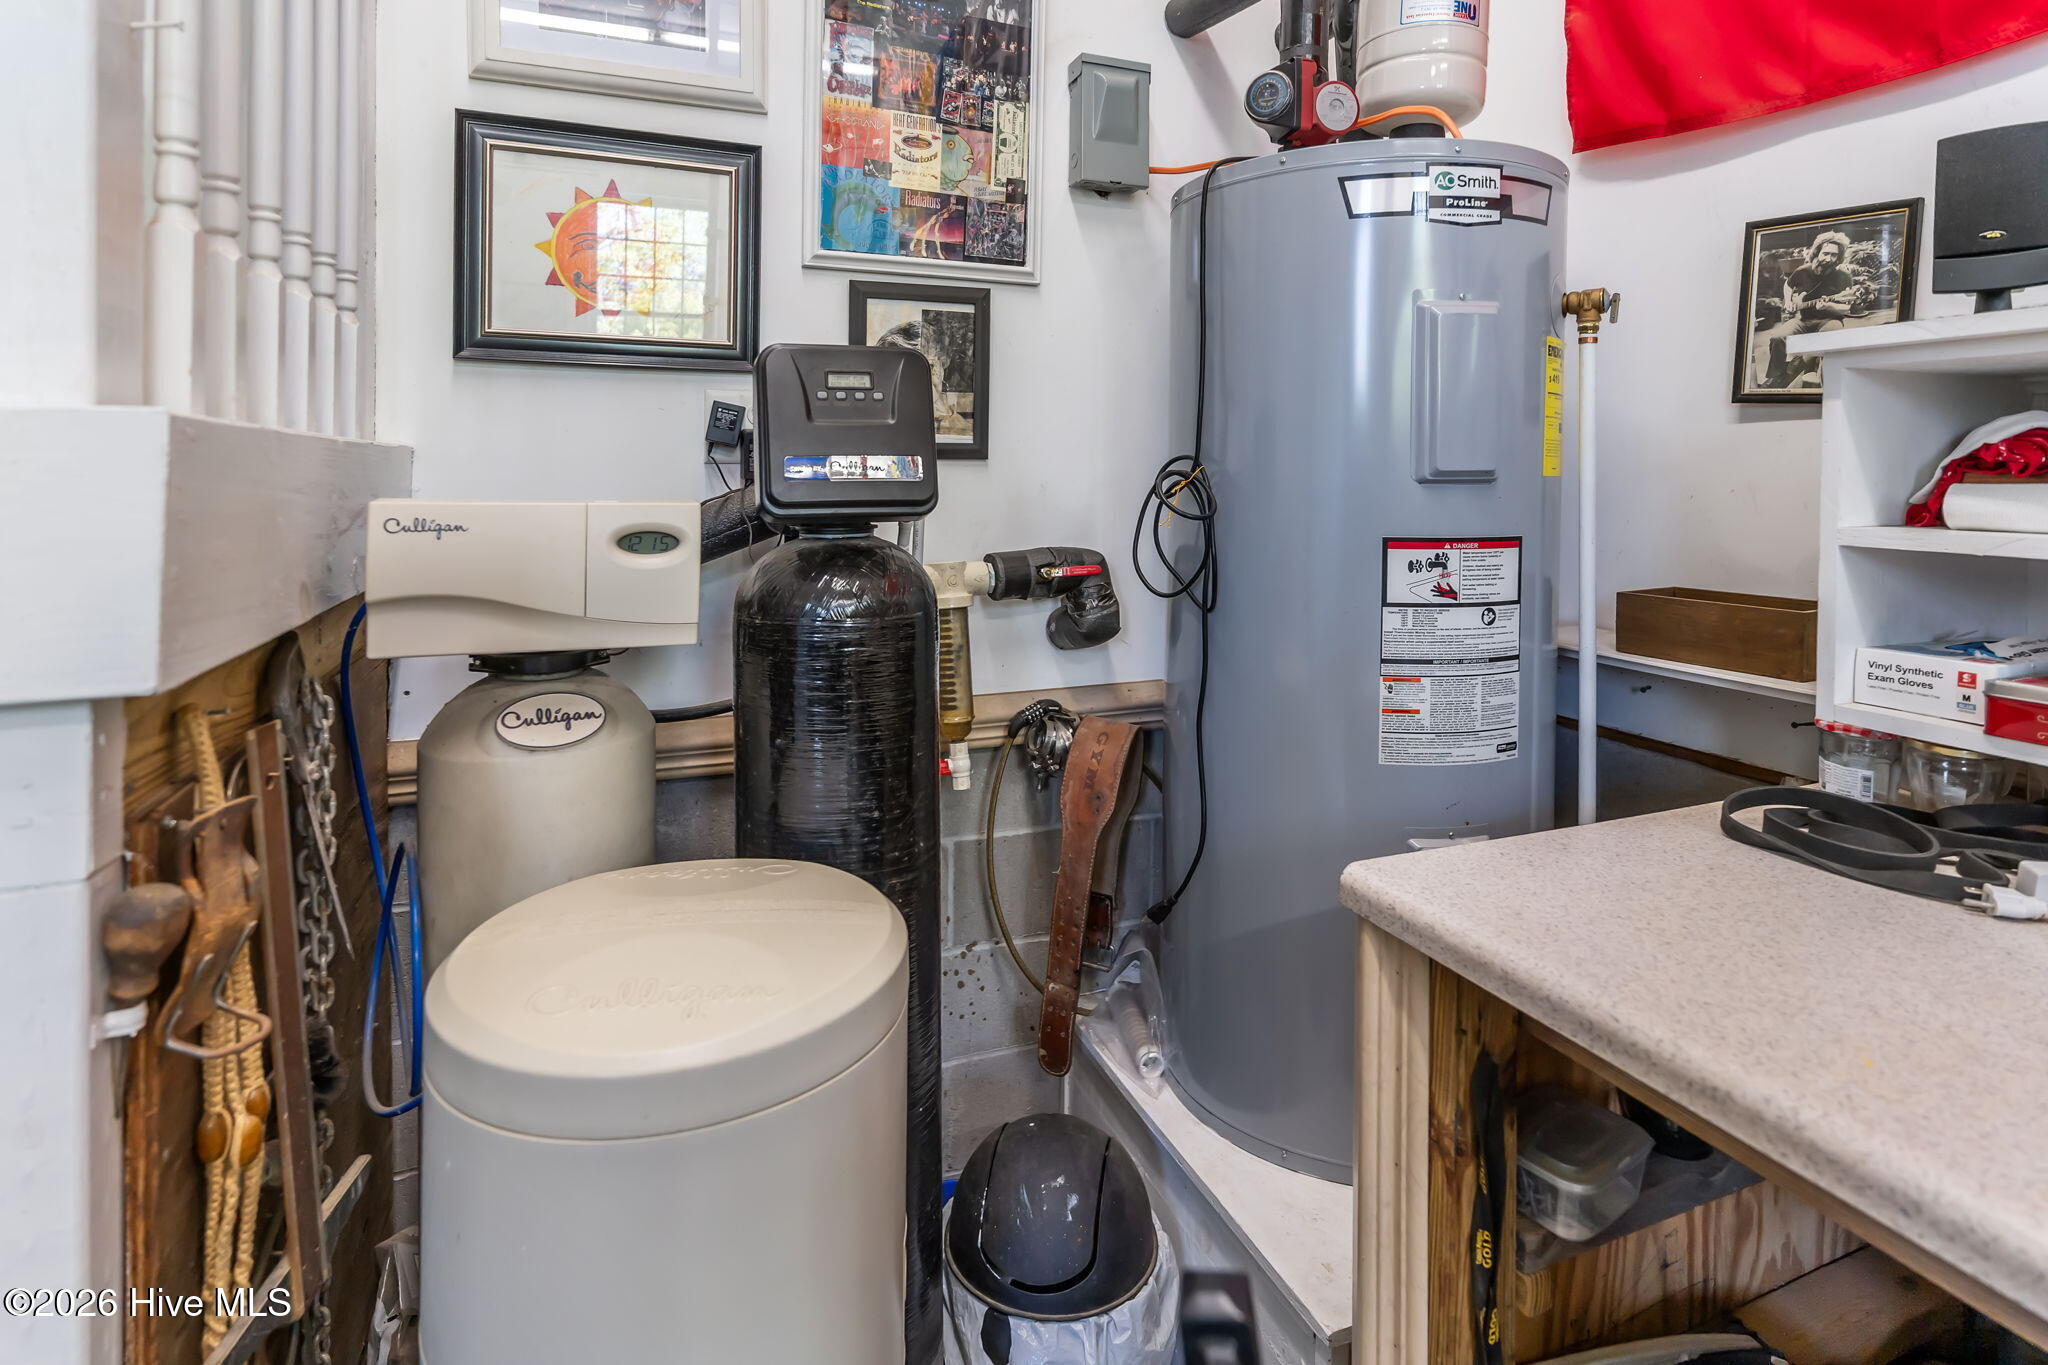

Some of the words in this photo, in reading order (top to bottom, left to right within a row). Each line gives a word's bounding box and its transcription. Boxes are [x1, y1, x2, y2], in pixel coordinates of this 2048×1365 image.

[905, 189, 941, 210] Radiators
[383, 517, 470, 541] Culligan
[1868, 660, 1893, 673] Vinyl
[1895, 664, 1944, 679] Synthetic
[1867, 672, 1895, 684] Exam
[1897, 676, 1934, 690] Gloves
[1962, 694, 1971, 703] M
[501, 707, 602, 731] Culligan
[524, 976, 785, 1023] Culligan
[1482, 1230, 1492, 1269] GOLD
